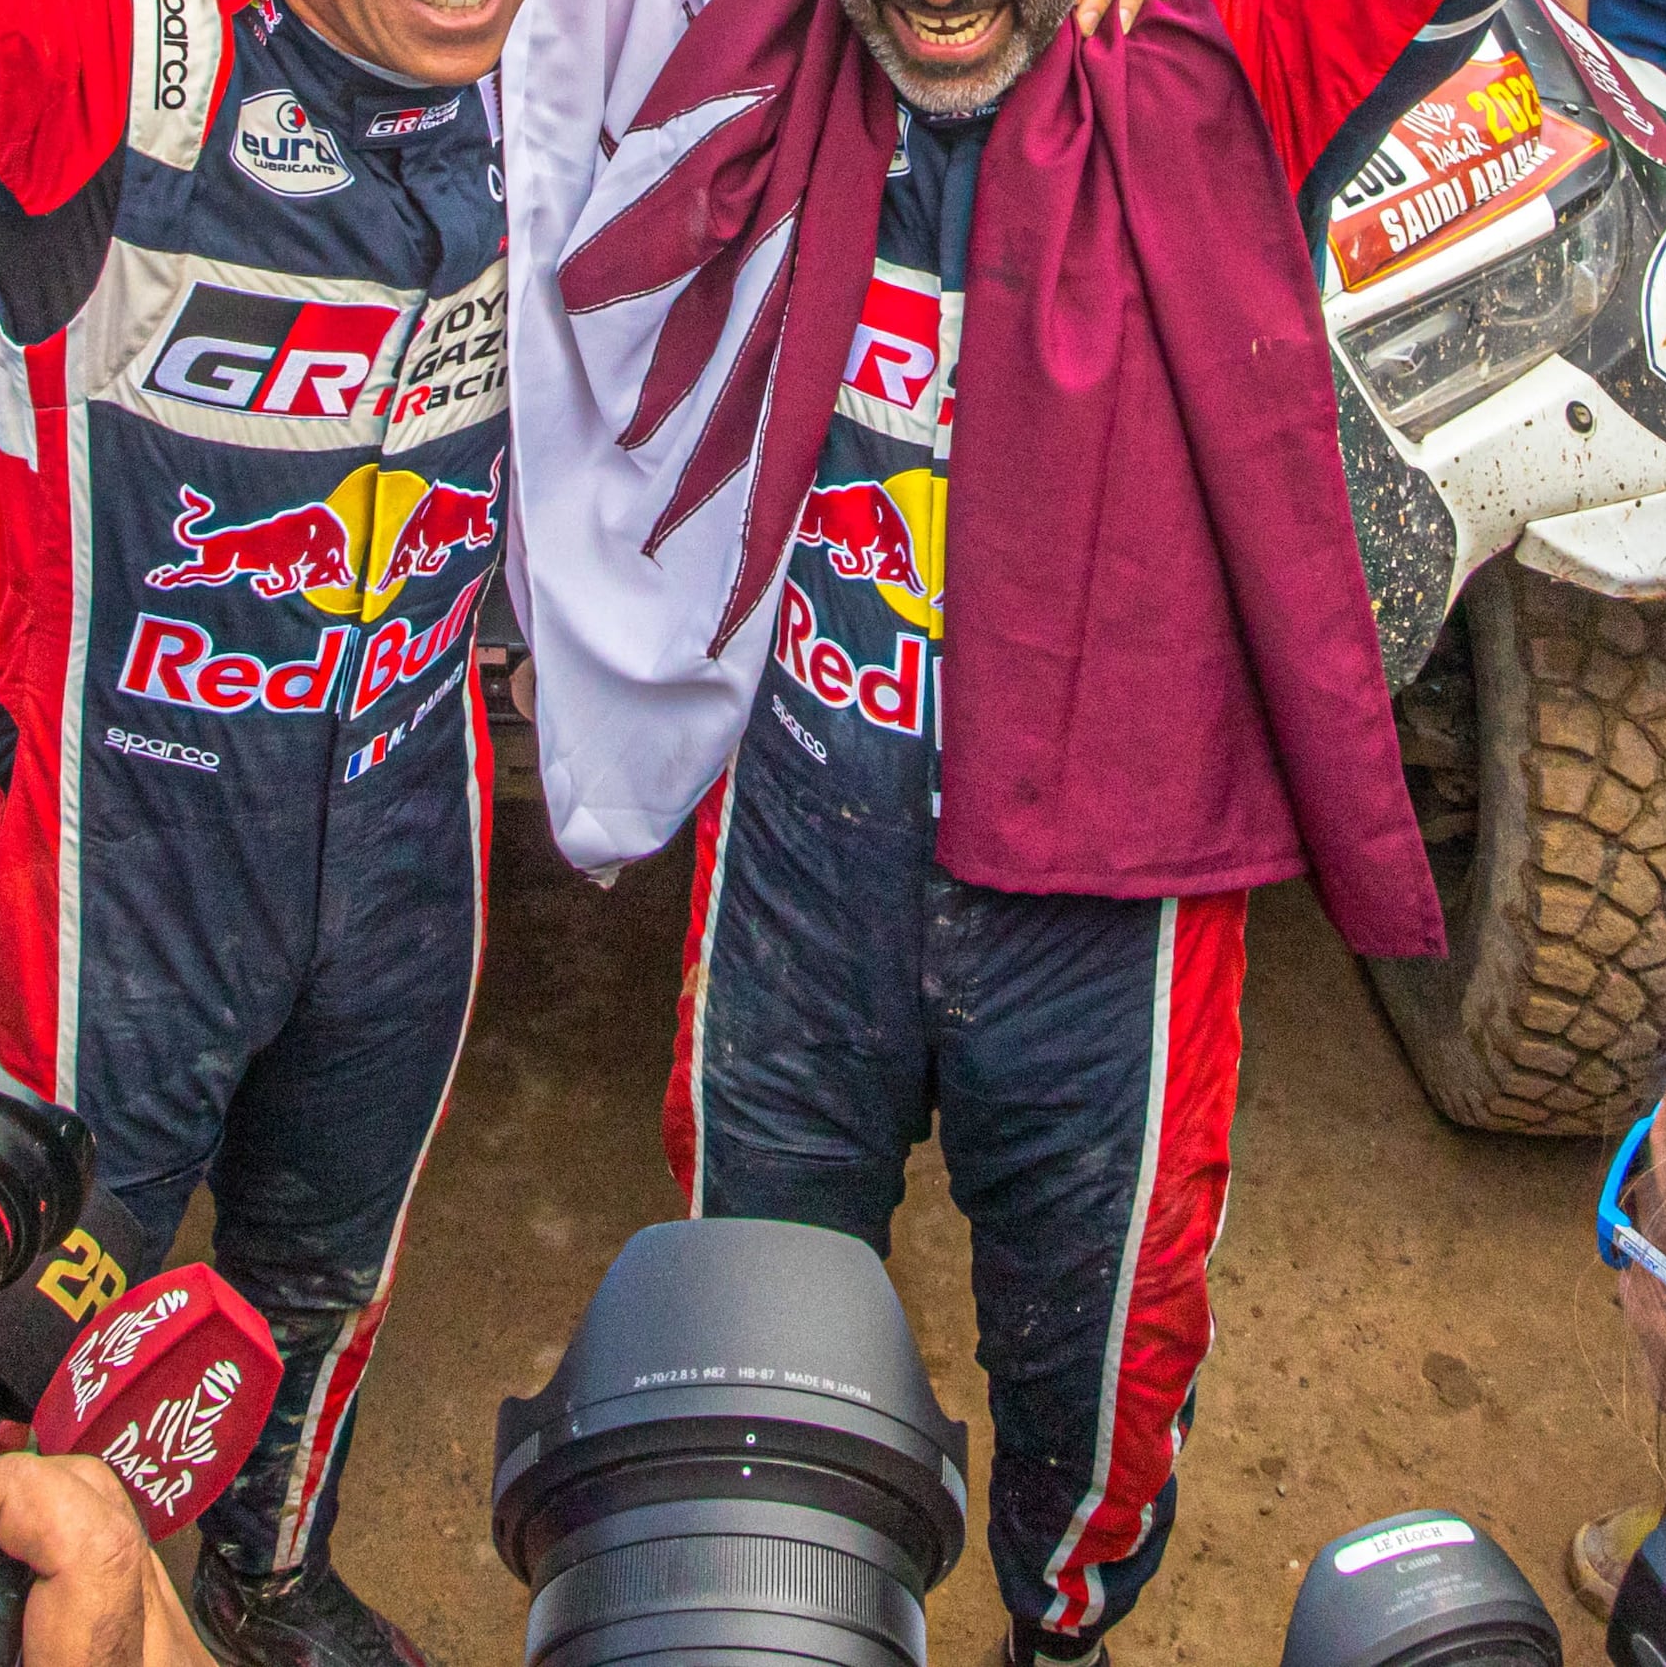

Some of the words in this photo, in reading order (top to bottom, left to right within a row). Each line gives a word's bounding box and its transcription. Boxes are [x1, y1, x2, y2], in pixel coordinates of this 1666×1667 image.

[369, 114, 420, 135] GR
[1417, 122, 1491, 173] DAKAR
[252, 157, 336, 177] LUBRICANTS
[1379, 176, 1468, 253] SAUDI
[1471, 134, 1557, 205] ARABIA
[153, 334, 371, 417] GR
[842, 326, 936, 410] R
[119, 611, 350, 715] Red
[351, 575, 484, 720] Bull
[775, 576, 926, 737] Red
[106, 726, 220, 771] sparco
[772, 694, 828, 764] sparco
[68, 1330, 109, 1422] DAKAR
[738, 1367, 776, 1380] HB-87
[784, 1370, 820, 1388] MADE
[821, 1377, 834, 1390] IN
[835, 1380, 871, 1403] JAPAN
[104, 1420, 197, 1515] DAKAR
[1373, 1538, 1394, 1554] LE
[1396, 1526, 1444, 1546] FLOCH
[1396, 1553, 1442, 1575] Canon
